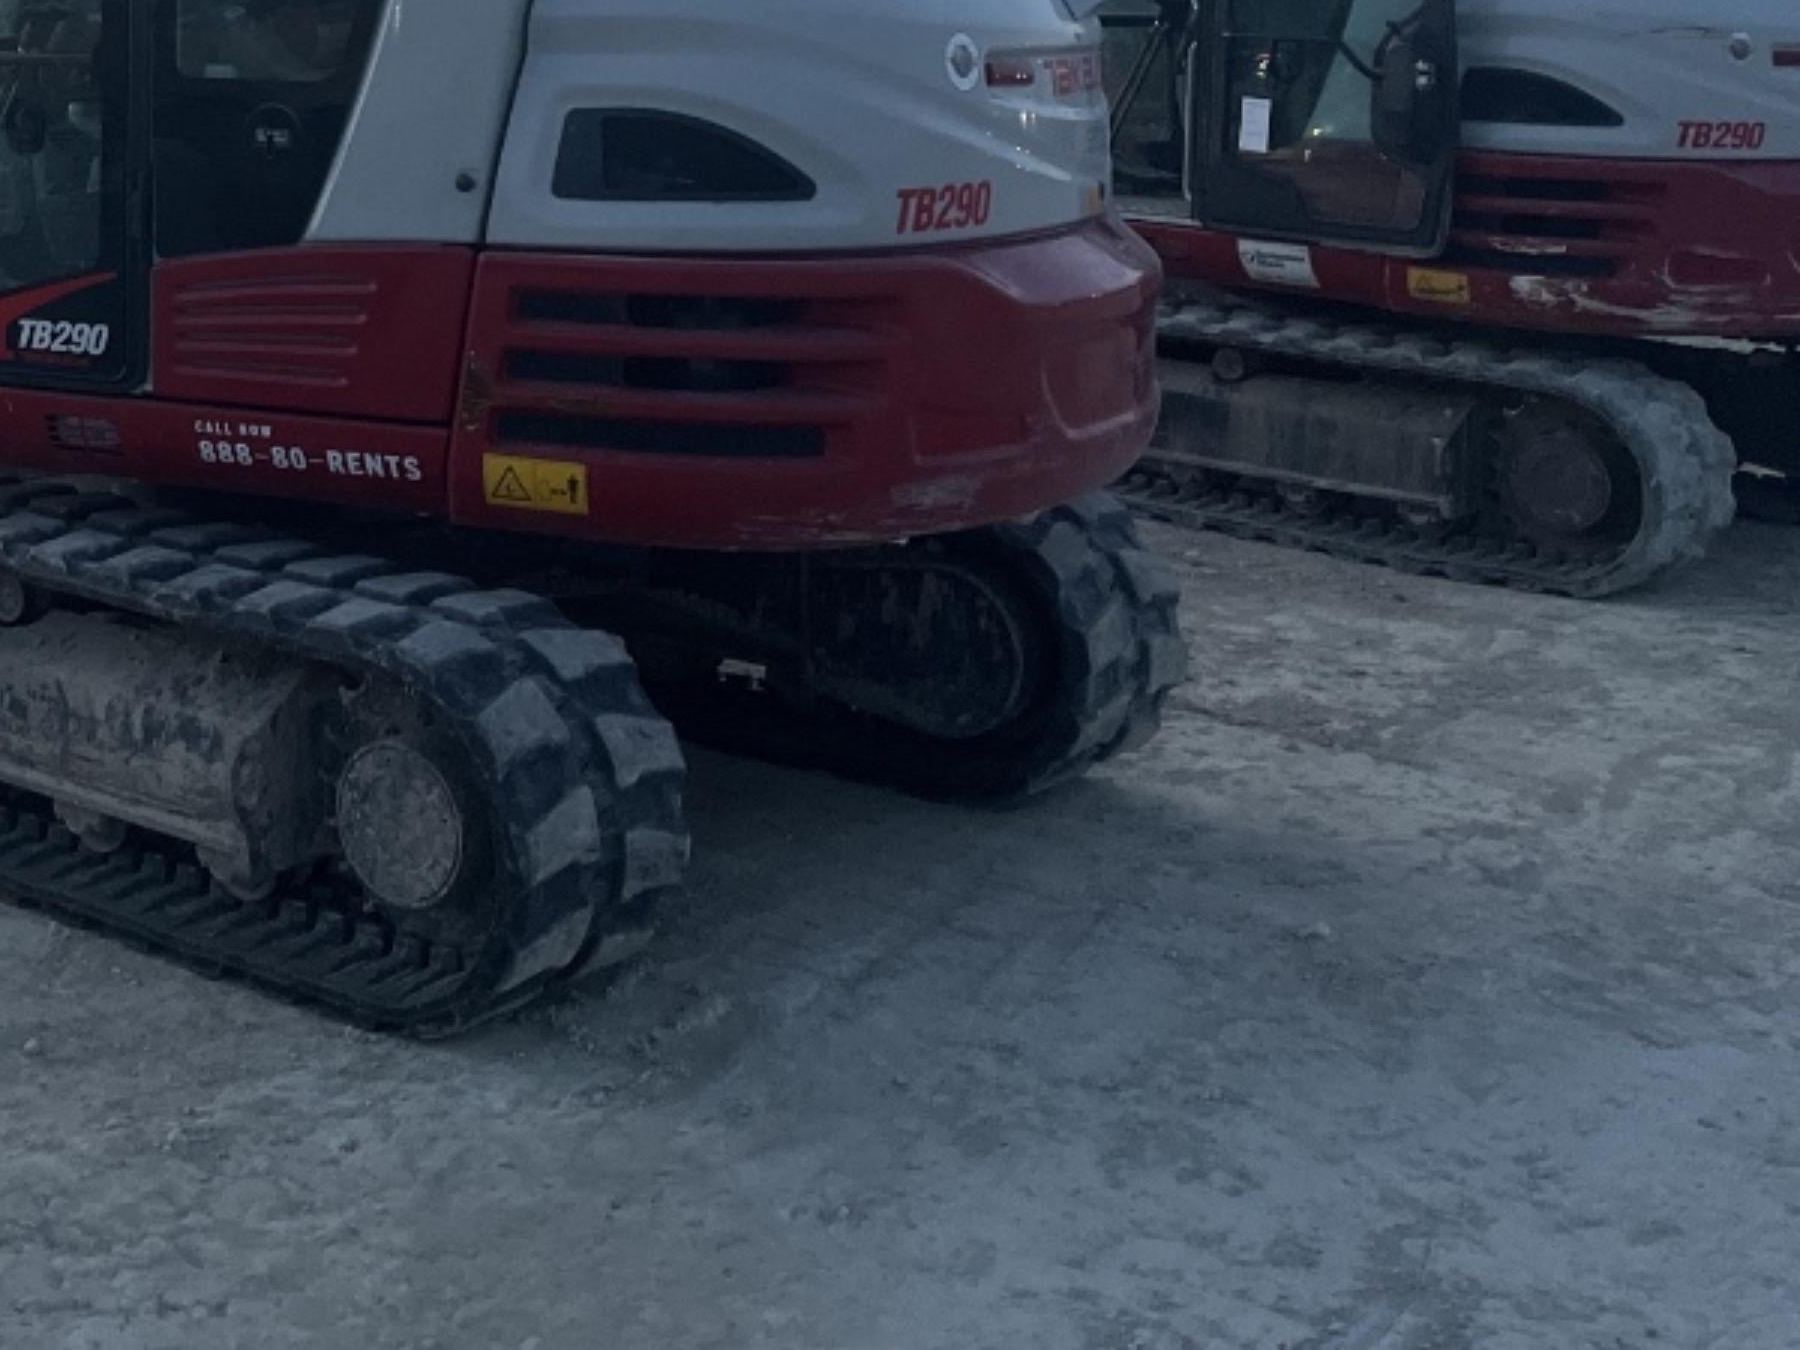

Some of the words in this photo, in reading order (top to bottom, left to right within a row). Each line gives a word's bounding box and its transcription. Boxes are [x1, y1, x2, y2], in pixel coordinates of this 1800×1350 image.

[1676, 119, 1766, 149] TB290
[895, 180, 992, 235] TB290
[17, 317, 110, 355] TB290
[194, 419, 232, 436] CALL
[198, 440, 422, 482] 888-80-RENTS
